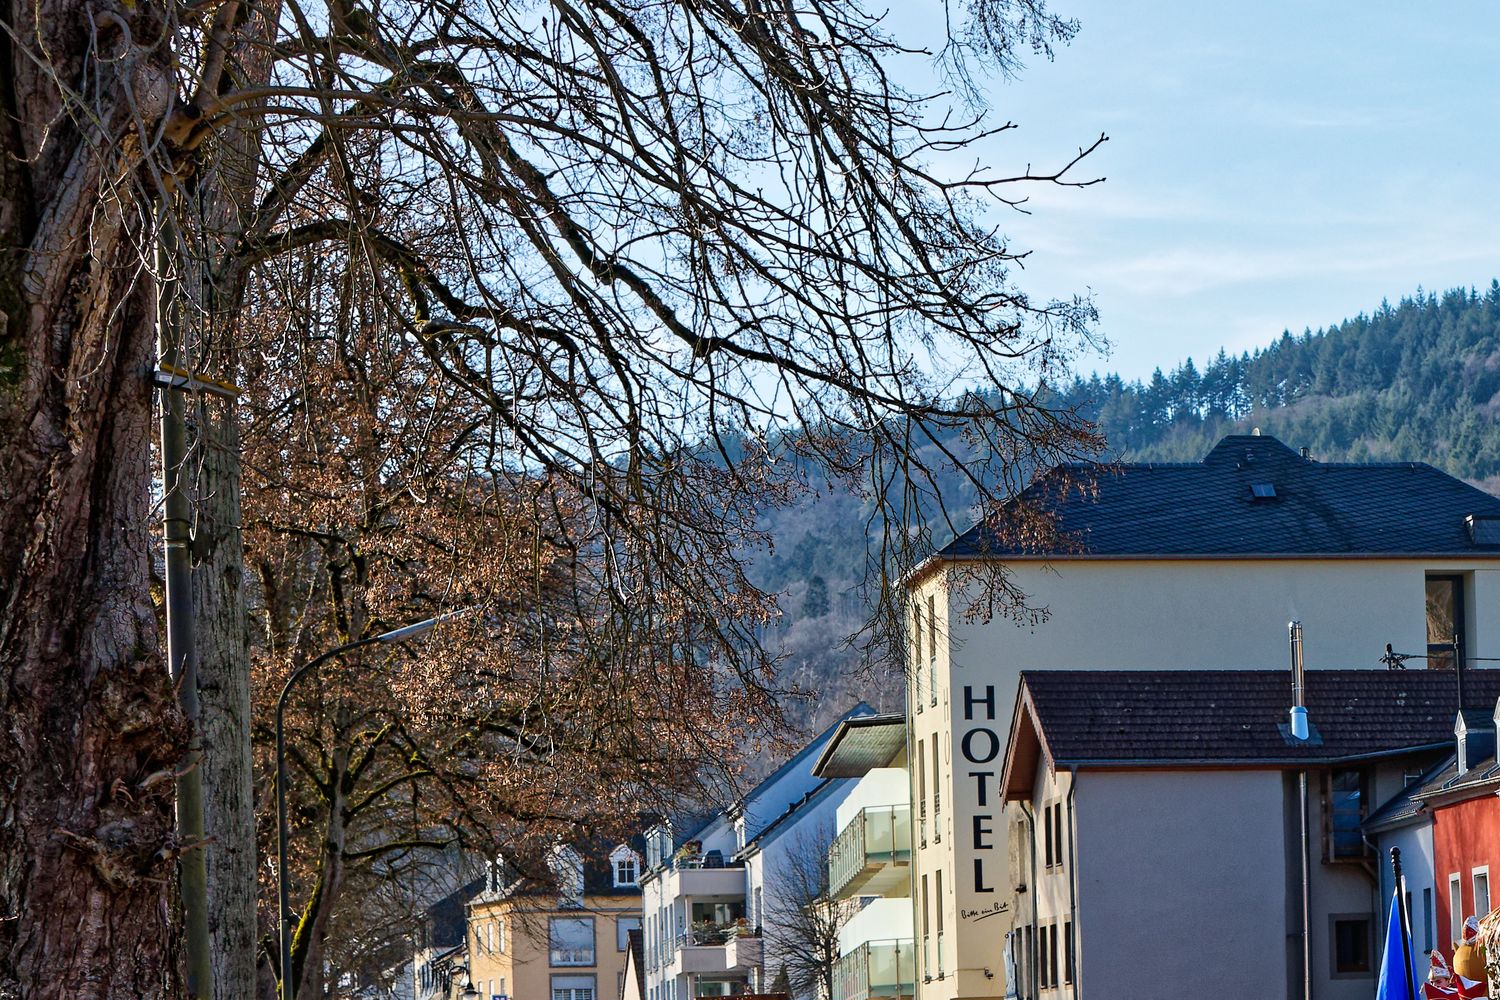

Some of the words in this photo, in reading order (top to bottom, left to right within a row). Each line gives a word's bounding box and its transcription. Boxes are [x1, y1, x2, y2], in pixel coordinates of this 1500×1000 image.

[961, 685, 1000, 892] HOTEL
[961, 909, 979, 919] Bitte
[981, 907, 993, 915] ein
[993, 901, 1008, 911] Bit
